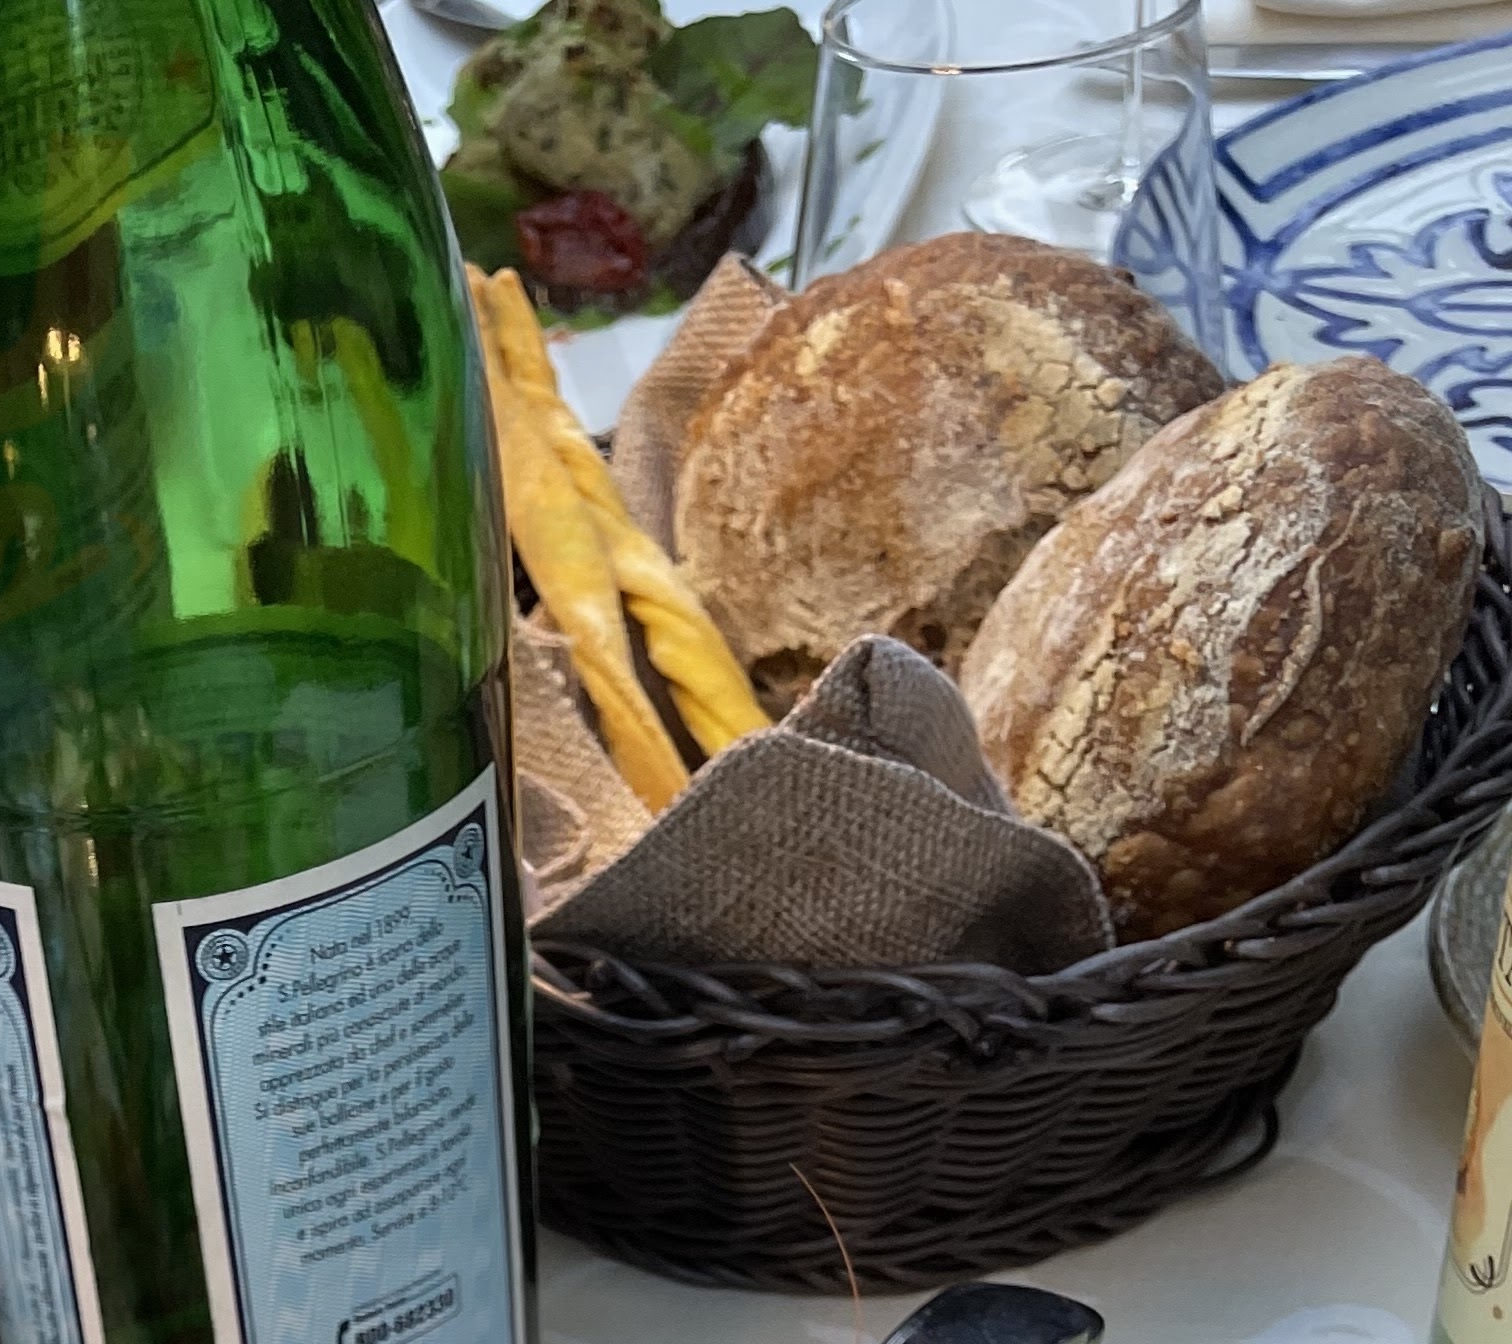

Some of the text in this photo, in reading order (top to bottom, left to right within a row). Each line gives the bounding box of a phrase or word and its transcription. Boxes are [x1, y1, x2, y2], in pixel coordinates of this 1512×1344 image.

[310, 942, 348, 964] Nata
[351, 921, 371, 948] nel
[252, 1032, 312, 1066] minerali
[343, 998, 411, 1039] conosciute
[413, 980, 426, 1005] al
[257, 1014, 287, 1038] stile
[290, 999, 346, 1028] italiano
[348, 982, 366, 1008] ed
[368, 979, 395, 999] una
[396, 960, 426, 985] delle
[253, 1102, 268, 1121] Si
[271, 1086, 339, 1116] distingue
[340, 1077, 364, 1099] per
[367, 1067, 381, 1083] la
[382, 1031, 450, 1076] persistenza
[259, 1056, 345, 1092] apprezzata
[347, 1041, 366, 1063] da
[368, 1023, 396, 1055] chef
[318, 1099, 376, 1129] bollicine
[390, 1081, 411, 1101] per
[424, 1056, 457, 1087] gusto
[298, 1120, 391, 1168] perfettamente
[283, 1198, 323, 1220] unica
[326, 1187, 357, 1209] ogni
[359, 1152, 430, 1194] esperienza
[310, 1214, 349, 1237] ispira
[351, 1202, 373, 1224] ad
[373, 1170, 442, 1213] assaporare
[370, 1213, 415, 1241] Servire
